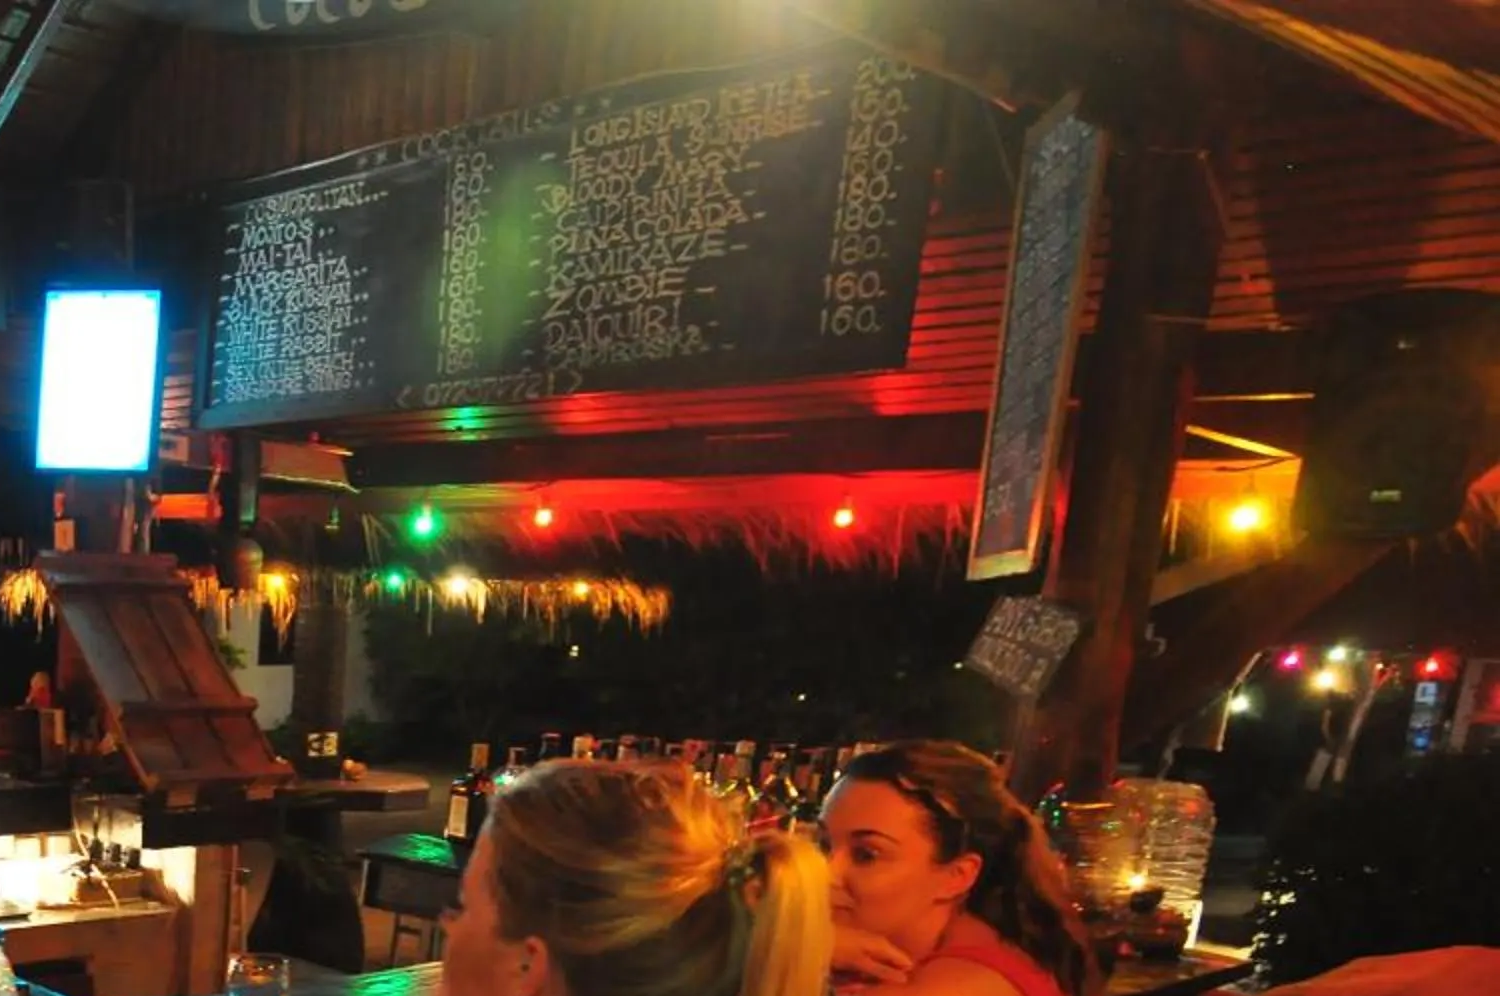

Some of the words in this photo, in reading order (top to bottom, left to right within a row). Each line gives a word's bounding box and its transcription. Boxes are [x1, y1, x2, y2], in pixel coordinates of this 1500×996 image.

[718, 85, 758, 119] ICE
[564, 134, 671, 180] TEQUILA
[685, 106, 808, 155] SUNRISE
[541, 168, 642, 214] BLOODY
[652, 142, 750, 189] MARY
[233, 255, 351, 301] MARGARITA
[546, 229, 729, 292] KAMIKAZE
[541, 264, 691, 320] ZOMBIE
[544, 296, 682, 348] DAIQUIRI
